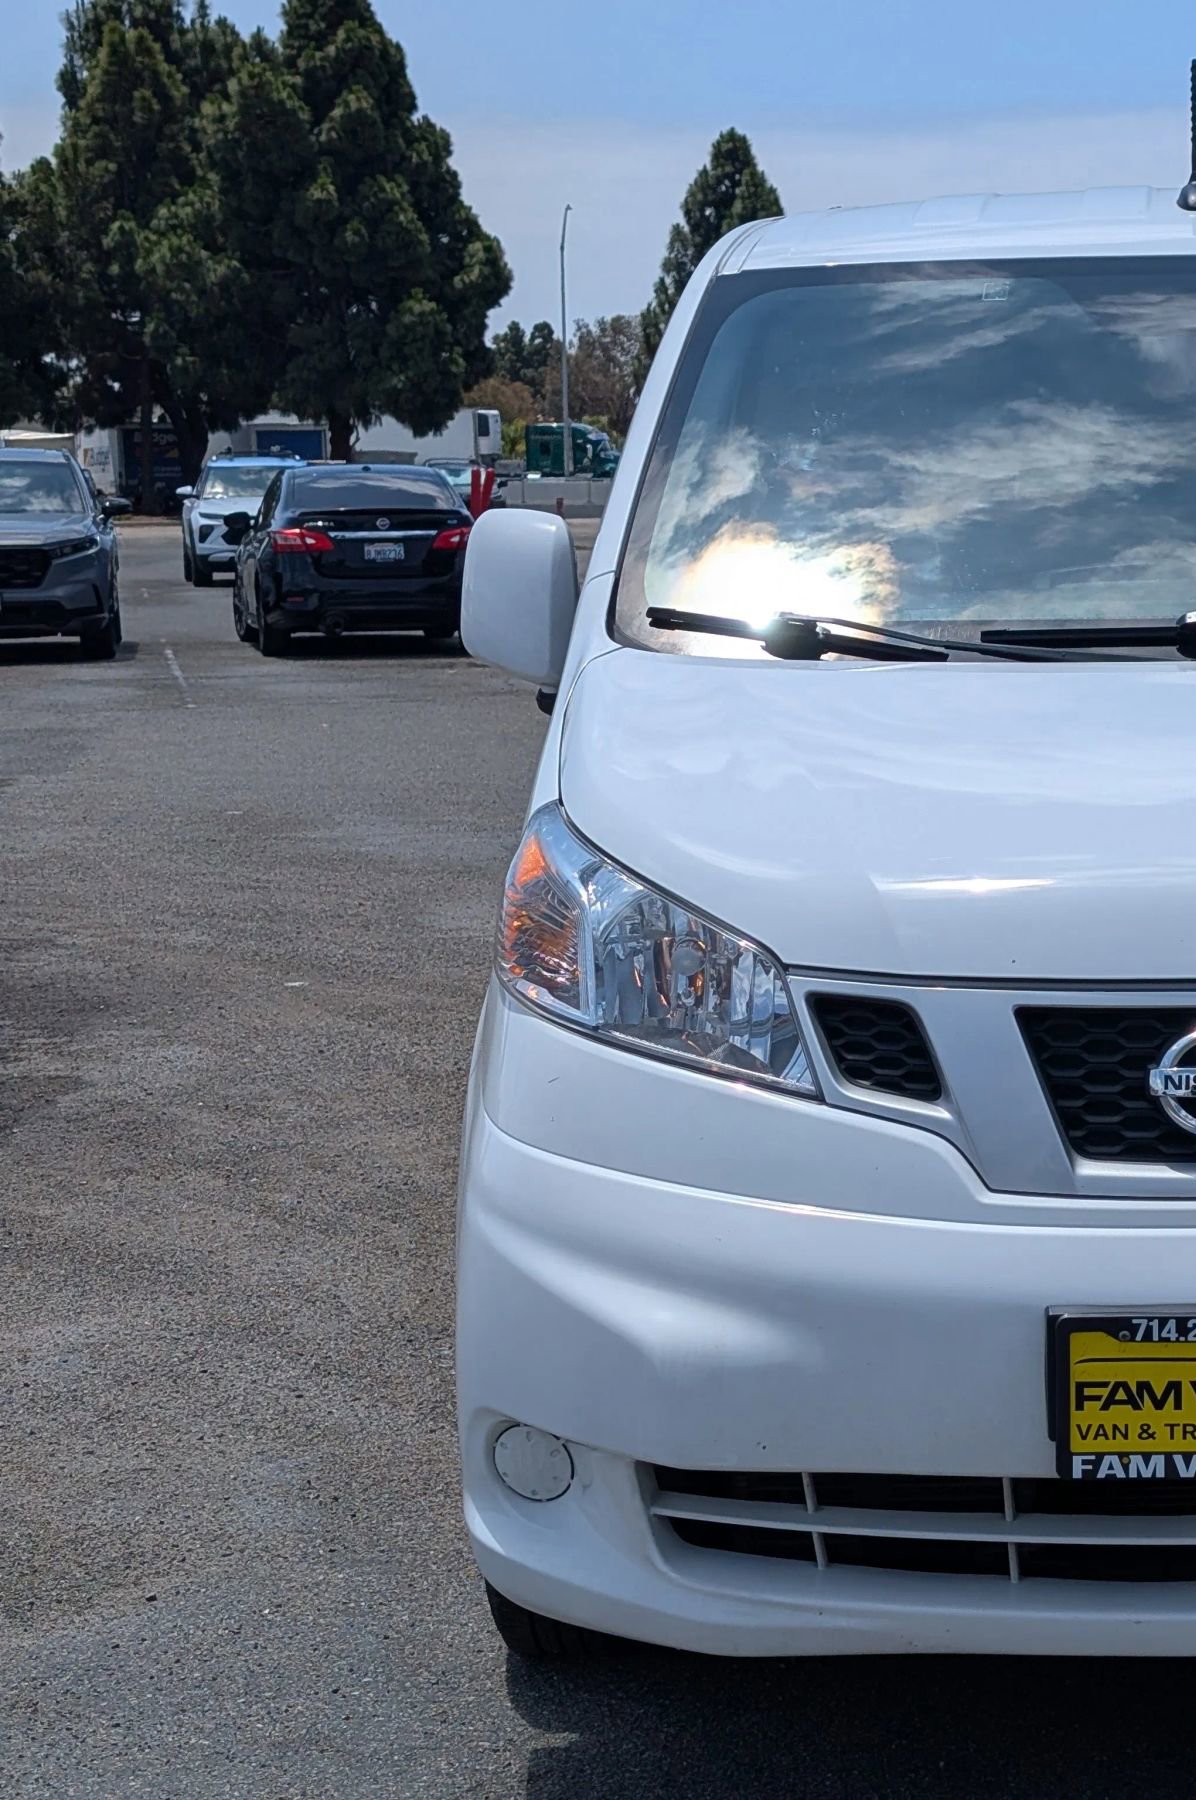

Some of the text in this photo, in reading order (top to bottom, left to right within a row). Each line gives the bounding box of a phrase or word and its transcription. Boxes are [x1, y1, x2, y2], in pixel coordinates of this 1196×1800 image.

[1074, 1380, 1183, 1411] FAM
[1075, 1423, 1129, 1440] VAN
[1136, 1423, 1156, 1440] &
